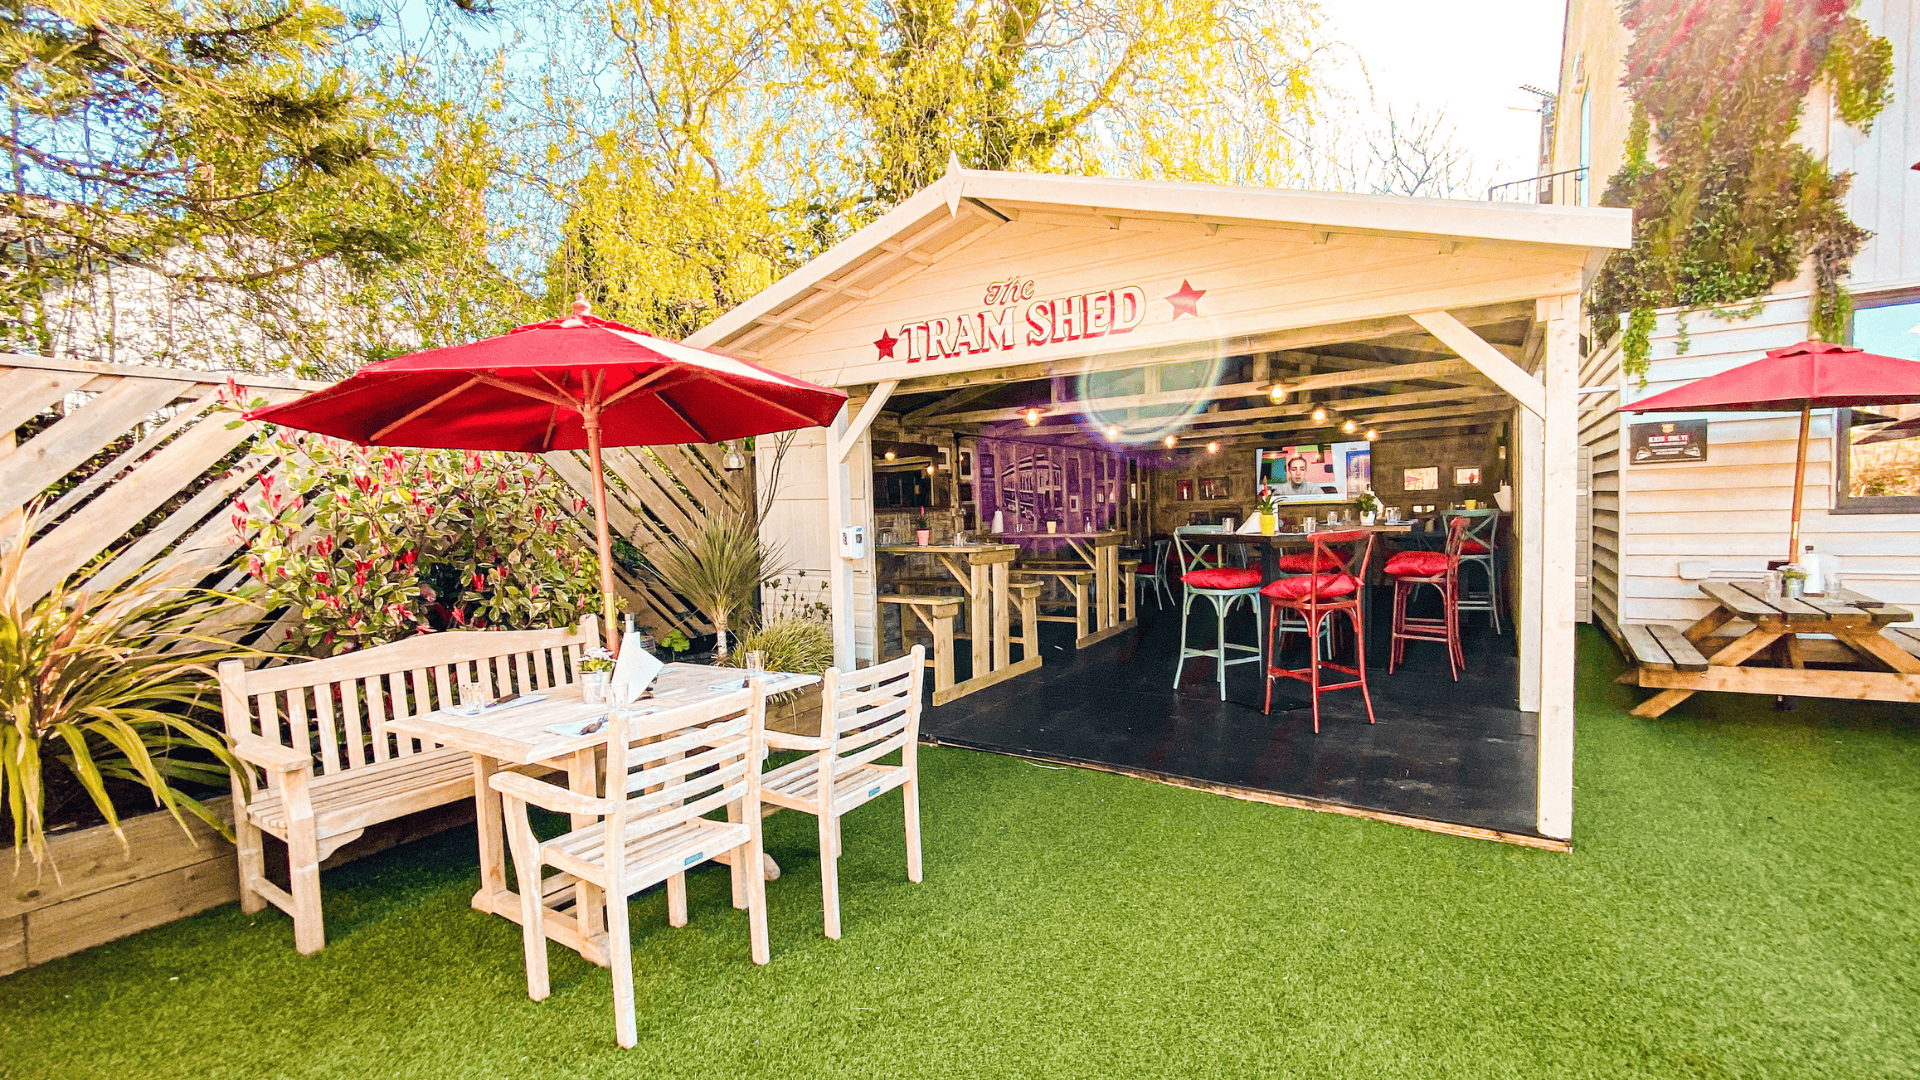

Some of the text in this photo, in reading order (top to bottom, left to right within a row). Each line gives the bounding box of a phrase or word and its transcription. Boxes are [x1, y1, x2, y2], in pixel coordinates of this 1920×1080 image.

[984, 276, 1035, 306] The
[899, 285, 1146, 364] TRAM SHED
